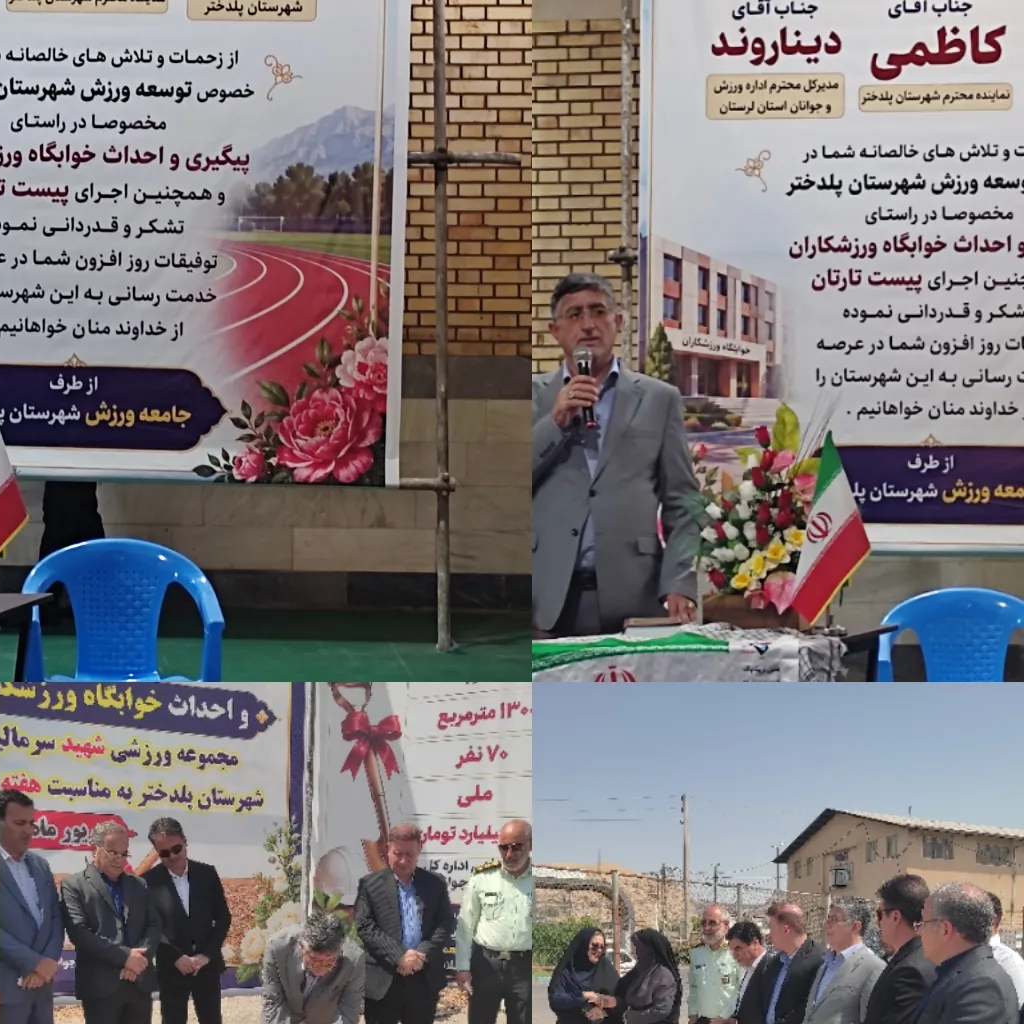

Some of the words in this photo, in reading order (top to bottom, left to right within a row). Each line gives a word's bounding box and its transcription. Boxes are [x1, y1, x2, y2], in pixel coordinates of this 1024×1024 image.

[204, 0, 244, 17] پلدختر
[247, 0, 303, 16] شهرستان
[774, 1, 818, 19] جناب
[5, 47, 68, 62] خالصانه
[711, 26, 842, 66] دیناروند
[870, 25, 1007, 81] کاظمی
[72, 48, 106, 67] های
[111, 48, 153, 68] تلاش
[157, 55, 164, 68] و
[169, 49, 223, 69] زحمات
[227, 50, 238, 69] از
[80, 78, 130, 103] ورزش
[136, 81, 192, 103] توسعه
[197, 84, 254, 103] خصوص
[714, 80, 743, 94] ورزش
[746, 80, 767, 94] اداره
[769, 81, 801, 94] محترم
[803, 79, 839, 93] مدیرکل
[976, 90, 1010, 102] نماینده
[757, 100, 787, 115] استان
[790, 100, 823, 114] جوانان
[861, 91, 893, 106] پلدختر
[895, 90, 941, 105] شهرستان
[942, 92, 974, 105] محترم
[719, 101, 755, 115] لرستان
[826, 104, 832, 114] و
[10, 113, 66, 133] راستای
[70, 117, 86, 134] در
[92, 114, 166, 135] مخصوصا
[28, 141, 96, 169] خوابگاه
[103, 145, 164, 164] احداث
[169, 153, 180, 171] و
[185, 144, 250, 172] پیگیری
[12, 182, 69, 206] پیست
[75, 182, 128, 204] اجرای
[133, 186, 212, 207] همچنین
[217, 192, 225, 206] و
[42, 216, 118, 238] قدردانی
[123, 224, 131, 238] و
[135, 218, 184, 239] تشکر
[10, 253, 28, 270] در
[33, 249, 70, 265] شما
[75, 249, 122, 272] افزون
[126, 254, 149, 273] روز
[154, 251, 218, 274] توفیقات
[50, 284, 79, 305] این
[84, 288, 103, 305] به
[108, 286, 160, 307] رسانی
[166, 288, 217, 303] خدمت
[72, 319, 110, 339] منان
[115, 320, 167, 341] خداوند
[171, 321, 183, 341] از
[49, 374, 83, 395] طرف
[86, 376, 98, 395] از
[9, 403, 81, 425] شهرستان
[85, 402, 135, 427] ورزش
[139, 405, 192, 428] جامعه
[83, 684, 162, 720] خوابگاه
[168, 694, 234, 720] احداث
[238, 708, 249, 730] و
[437, 706, 496, 730] مترمربع
[61, 736, 105, 758] شهید
[111, 739, 172, 766] ورزشی
[455, 745, 483, 769] نفر
[487, 744, 509, 762] ۷۰
[177, 749, 239, 771] مجموعه
[47, 778, 111, 801] مناسبت
[117, 784, 133, 806] به
[138, 785, 193, 811] پلدختر
[457, 784, 493, 808] ملی
[197, 789, 264, 812] شهرستان
